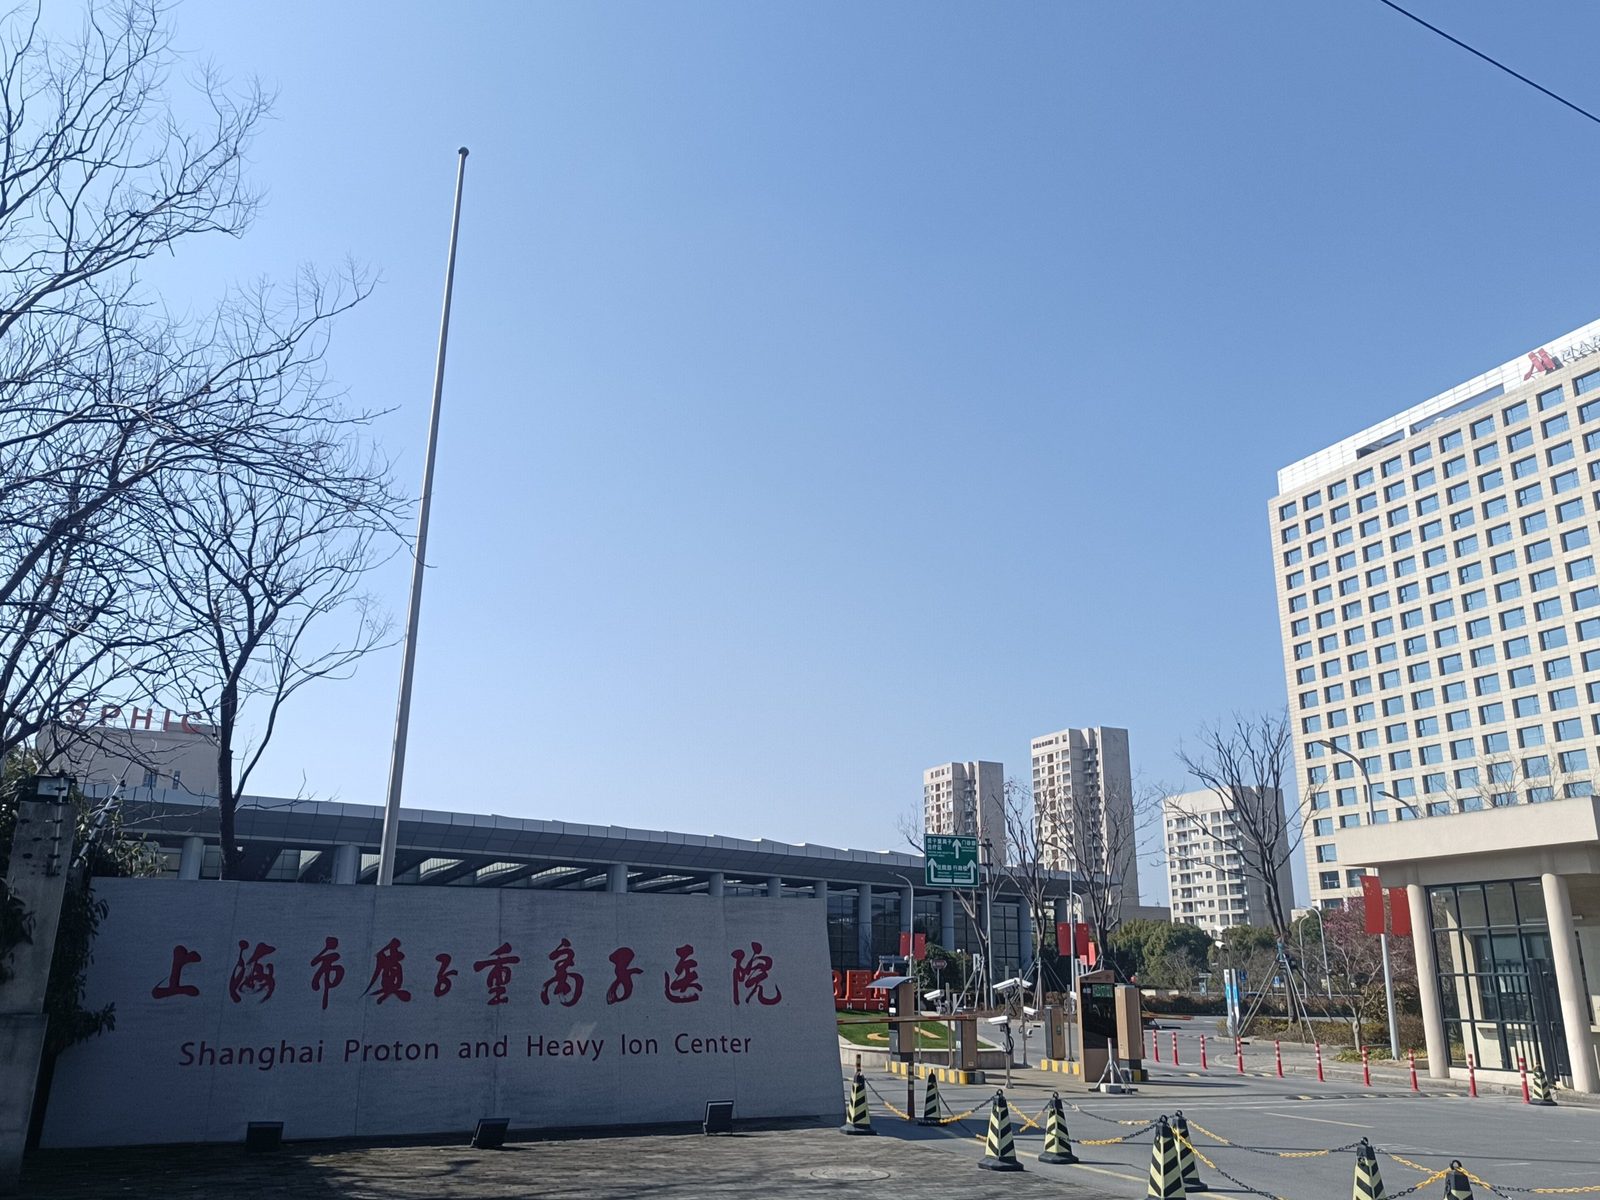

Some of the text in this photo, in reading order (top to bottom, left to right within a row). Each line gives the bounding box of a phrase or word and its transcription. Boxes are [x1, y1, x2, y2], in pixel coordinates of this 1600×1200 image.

[66, 700, 201, 734] SPHIC
[152, 936, 782, 1010] 上海市质子重离子医院
[179, 1032, 752, 1071] Shanghai Proton and Heavy Ion Center
